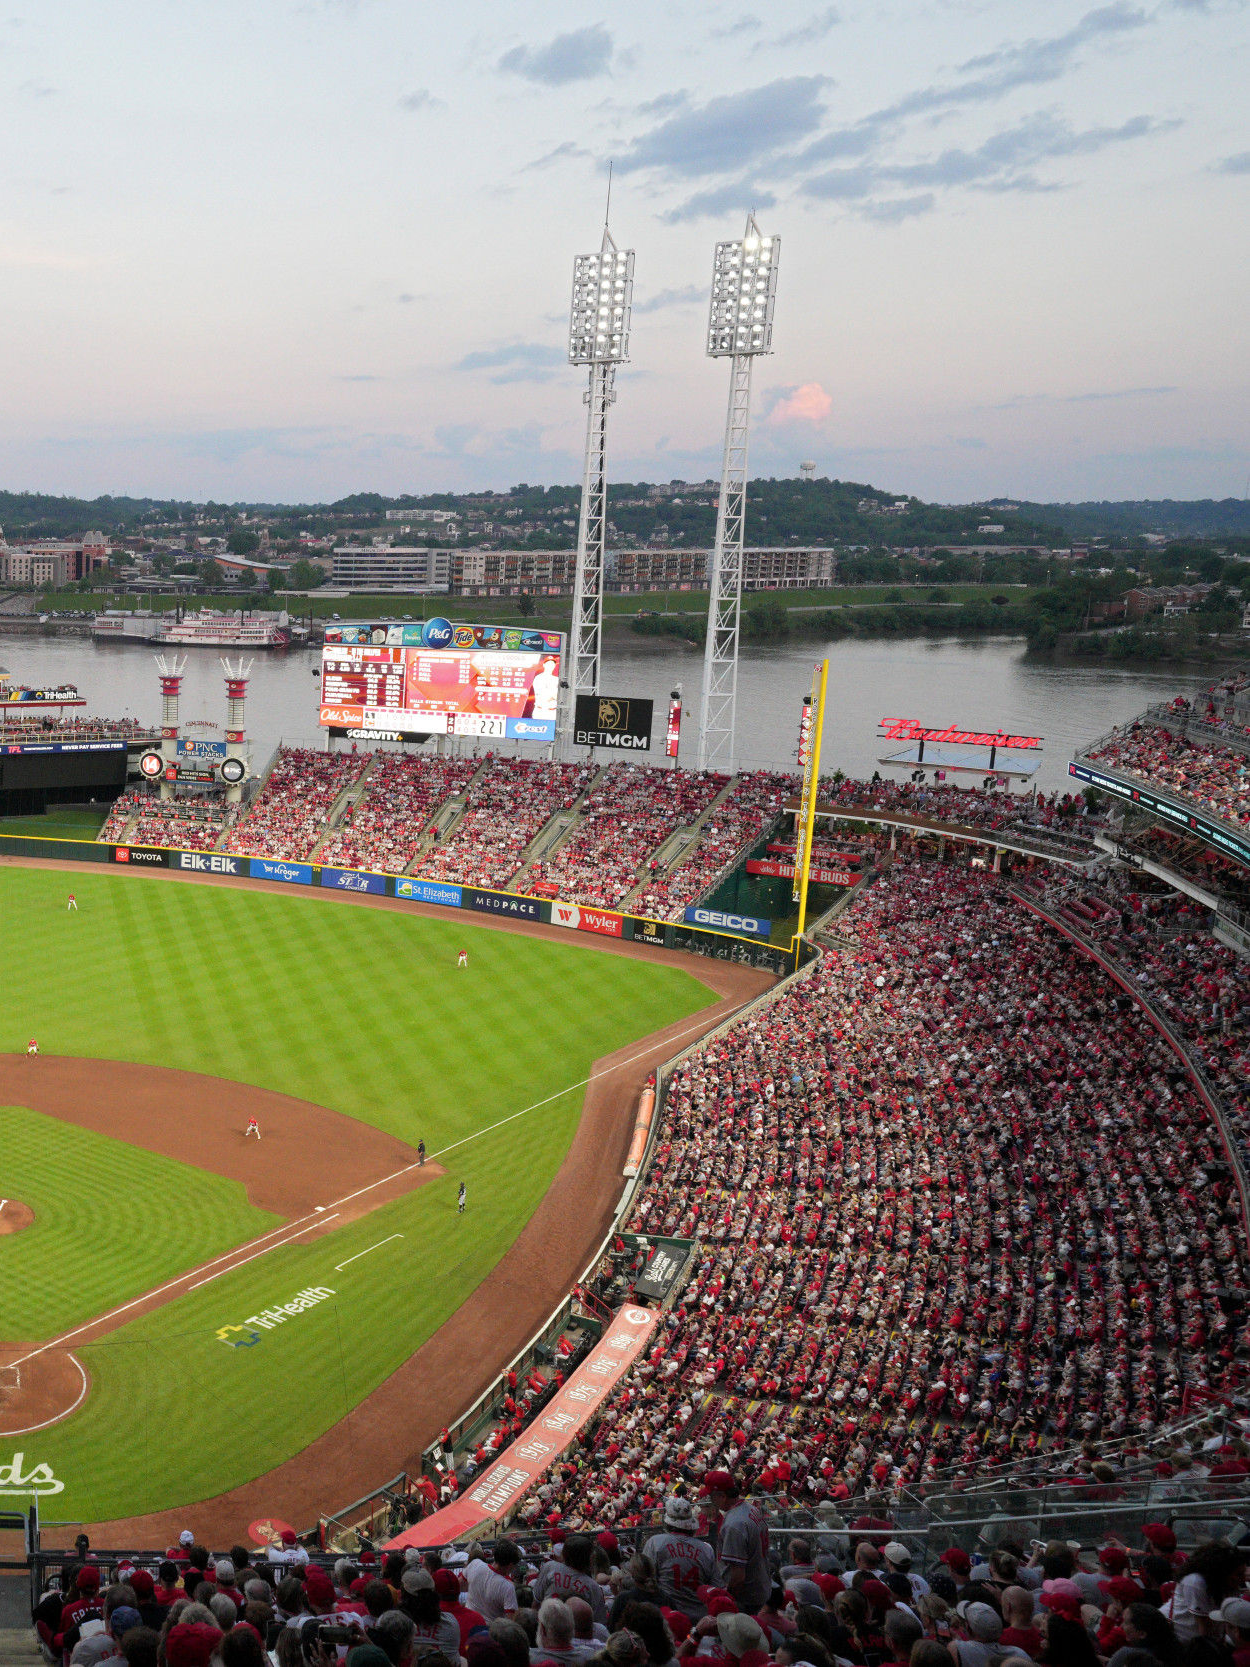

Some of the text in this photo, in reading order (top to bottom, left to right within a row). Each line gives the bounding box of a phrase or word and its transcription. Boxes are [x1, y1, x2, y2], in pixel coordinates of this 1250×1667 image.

[428, 628, 451, 639] P&G
[455, 632, 473, 643] Tide
[44, 691, 77, 700] TriHealth
[321, 709, 362, 723] Old Spice
[353, 729, 398, 741] GRAVITY
[517, 723, 548, 733] Crest
[879, 718, 1042, 749] Budweiser
[195, 743, 218, 752] PNC
[576, 731, 648, 749] BETMGM
[8, 746, 22, 754] TFL
[145, 758, 159, 771] 14
[132, 852, 162, 861] TOYOTA
[274, 864, 299, 880] Kroger
[779, 866, 850, 885] HIT BUDS
[413, 886, 460, 899] St. Elizabeth
[476, 897, 535, 914] MEDPACE
[584, 913, 618, 929] Wyler
[694, 909, 759, 932] GEICO
[634, 933, 664, 944] BETMGM
[244, 1286, 336, 1329] TriHealth
[573, 1385, 598, 1402] 1975
[550, 1412, 574, 1429] 1940
[523, 1441, 550, 1461] 1919
[470, 1465, 512, 1502] WORLD SERIES
[481, 1468, 530, 1512] CHAMPIONS
[667, 1543, 702, 1561] ROSE
[554, 1572, 589, 1595] ROSE
[671, 1564, 699, 1590] 14
